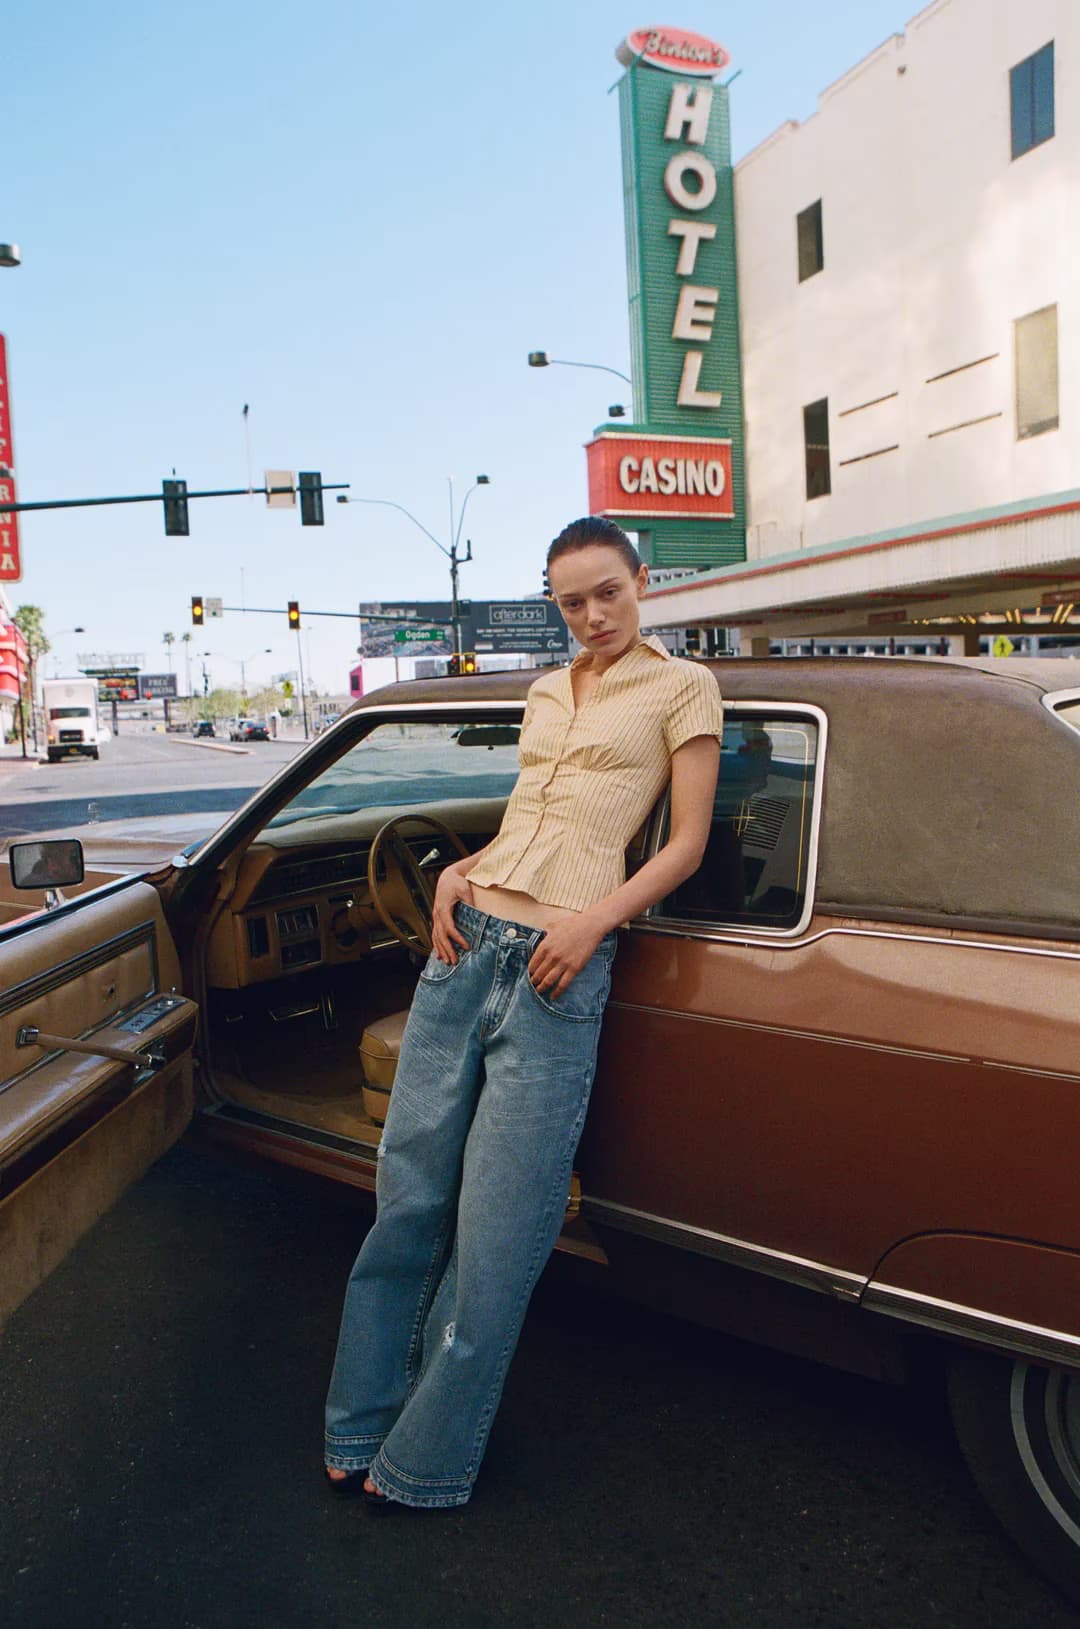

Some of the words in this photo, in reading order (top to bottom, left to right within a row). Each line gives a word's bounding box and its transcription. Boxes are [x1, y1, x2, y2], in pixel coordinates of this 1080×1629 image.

[637, 30, 724, 65] Binion's
[664, 82, 722, 409] HOTEL
[620, 454, 726, 497] CASINO
[405, 630, 431, 640] Ogden
